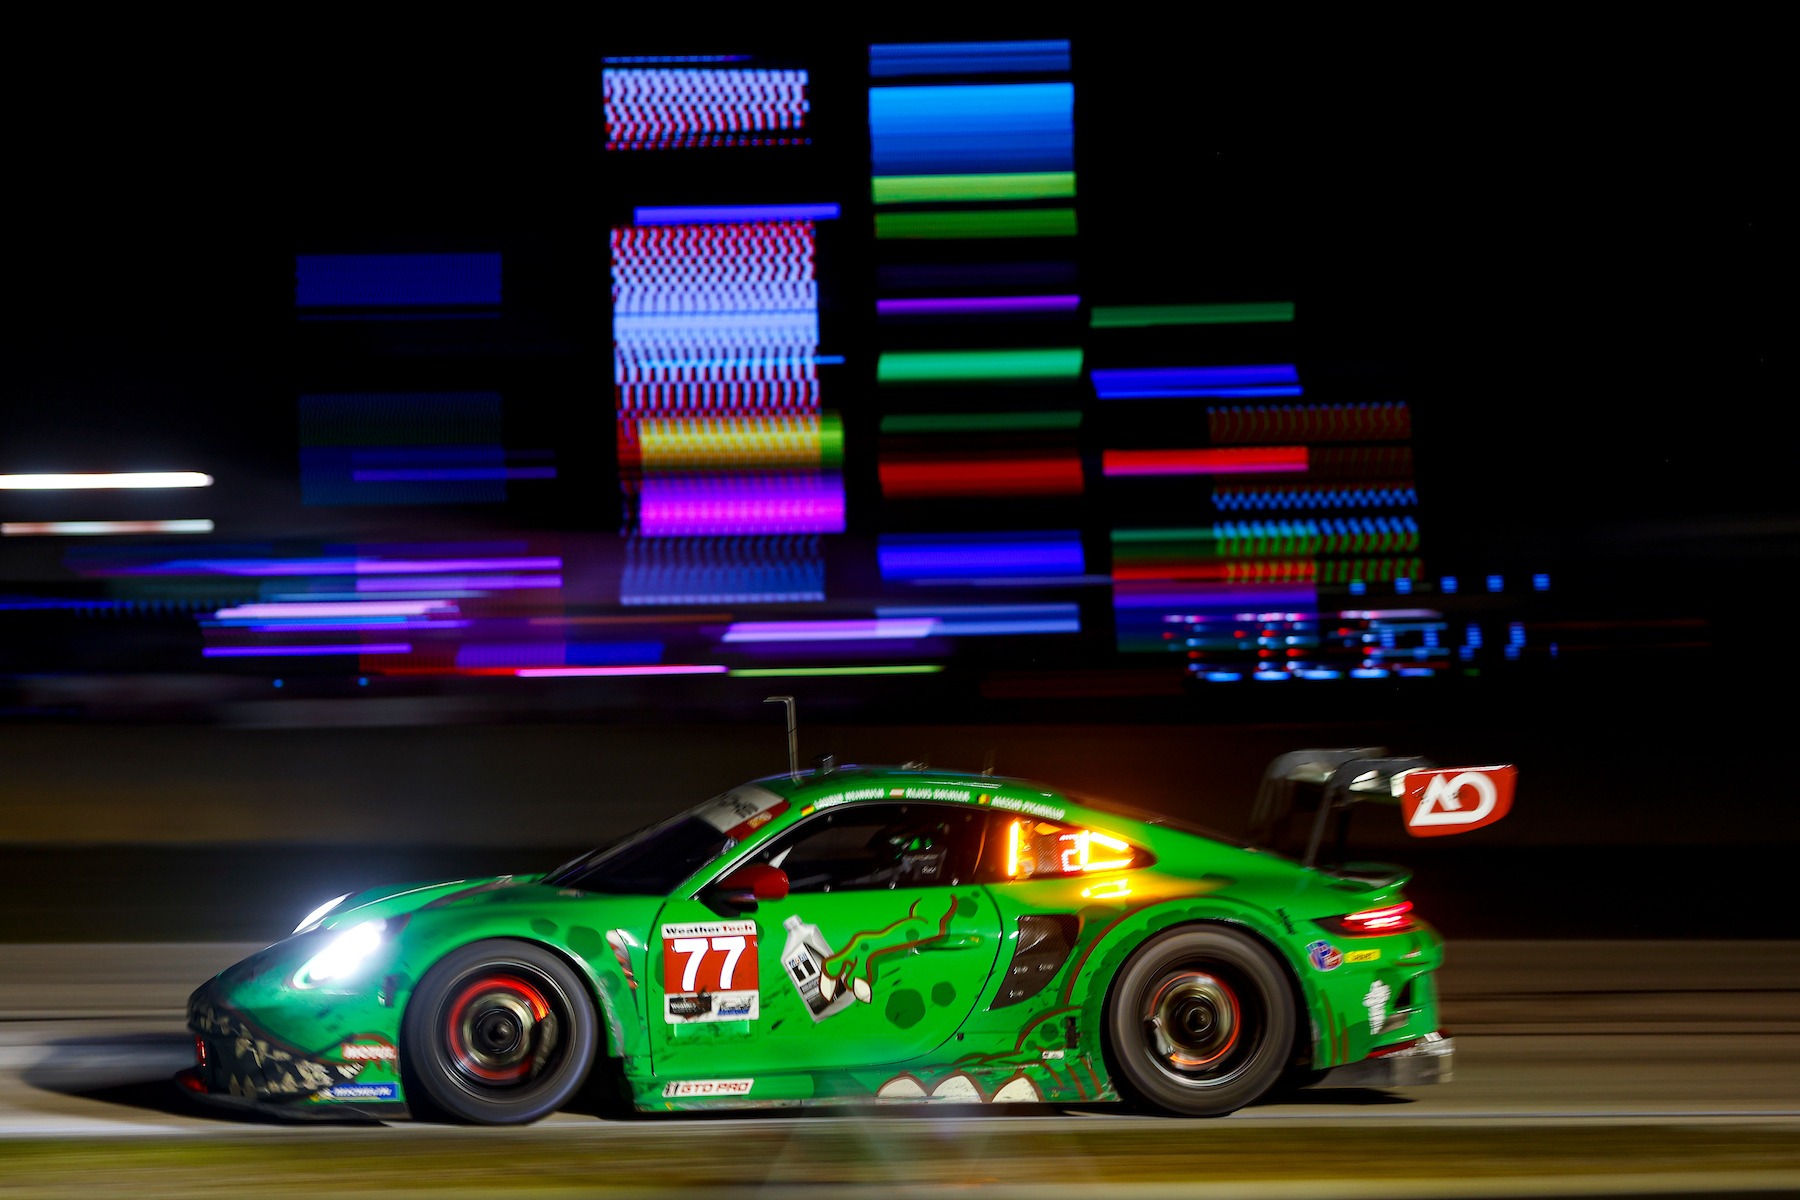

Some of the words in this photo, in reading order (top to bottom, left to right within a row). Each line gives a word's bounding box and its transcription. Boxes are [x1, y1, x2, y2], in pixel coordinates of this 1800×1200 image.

[1409, 771, 1497, 827] AO
[665, 924, 753, 935] WeatherTech
[673, 936, 747, 992] 77
[681, 1083, 713, 1094] GTD
[716, 1082, 749, 1093] PRO
